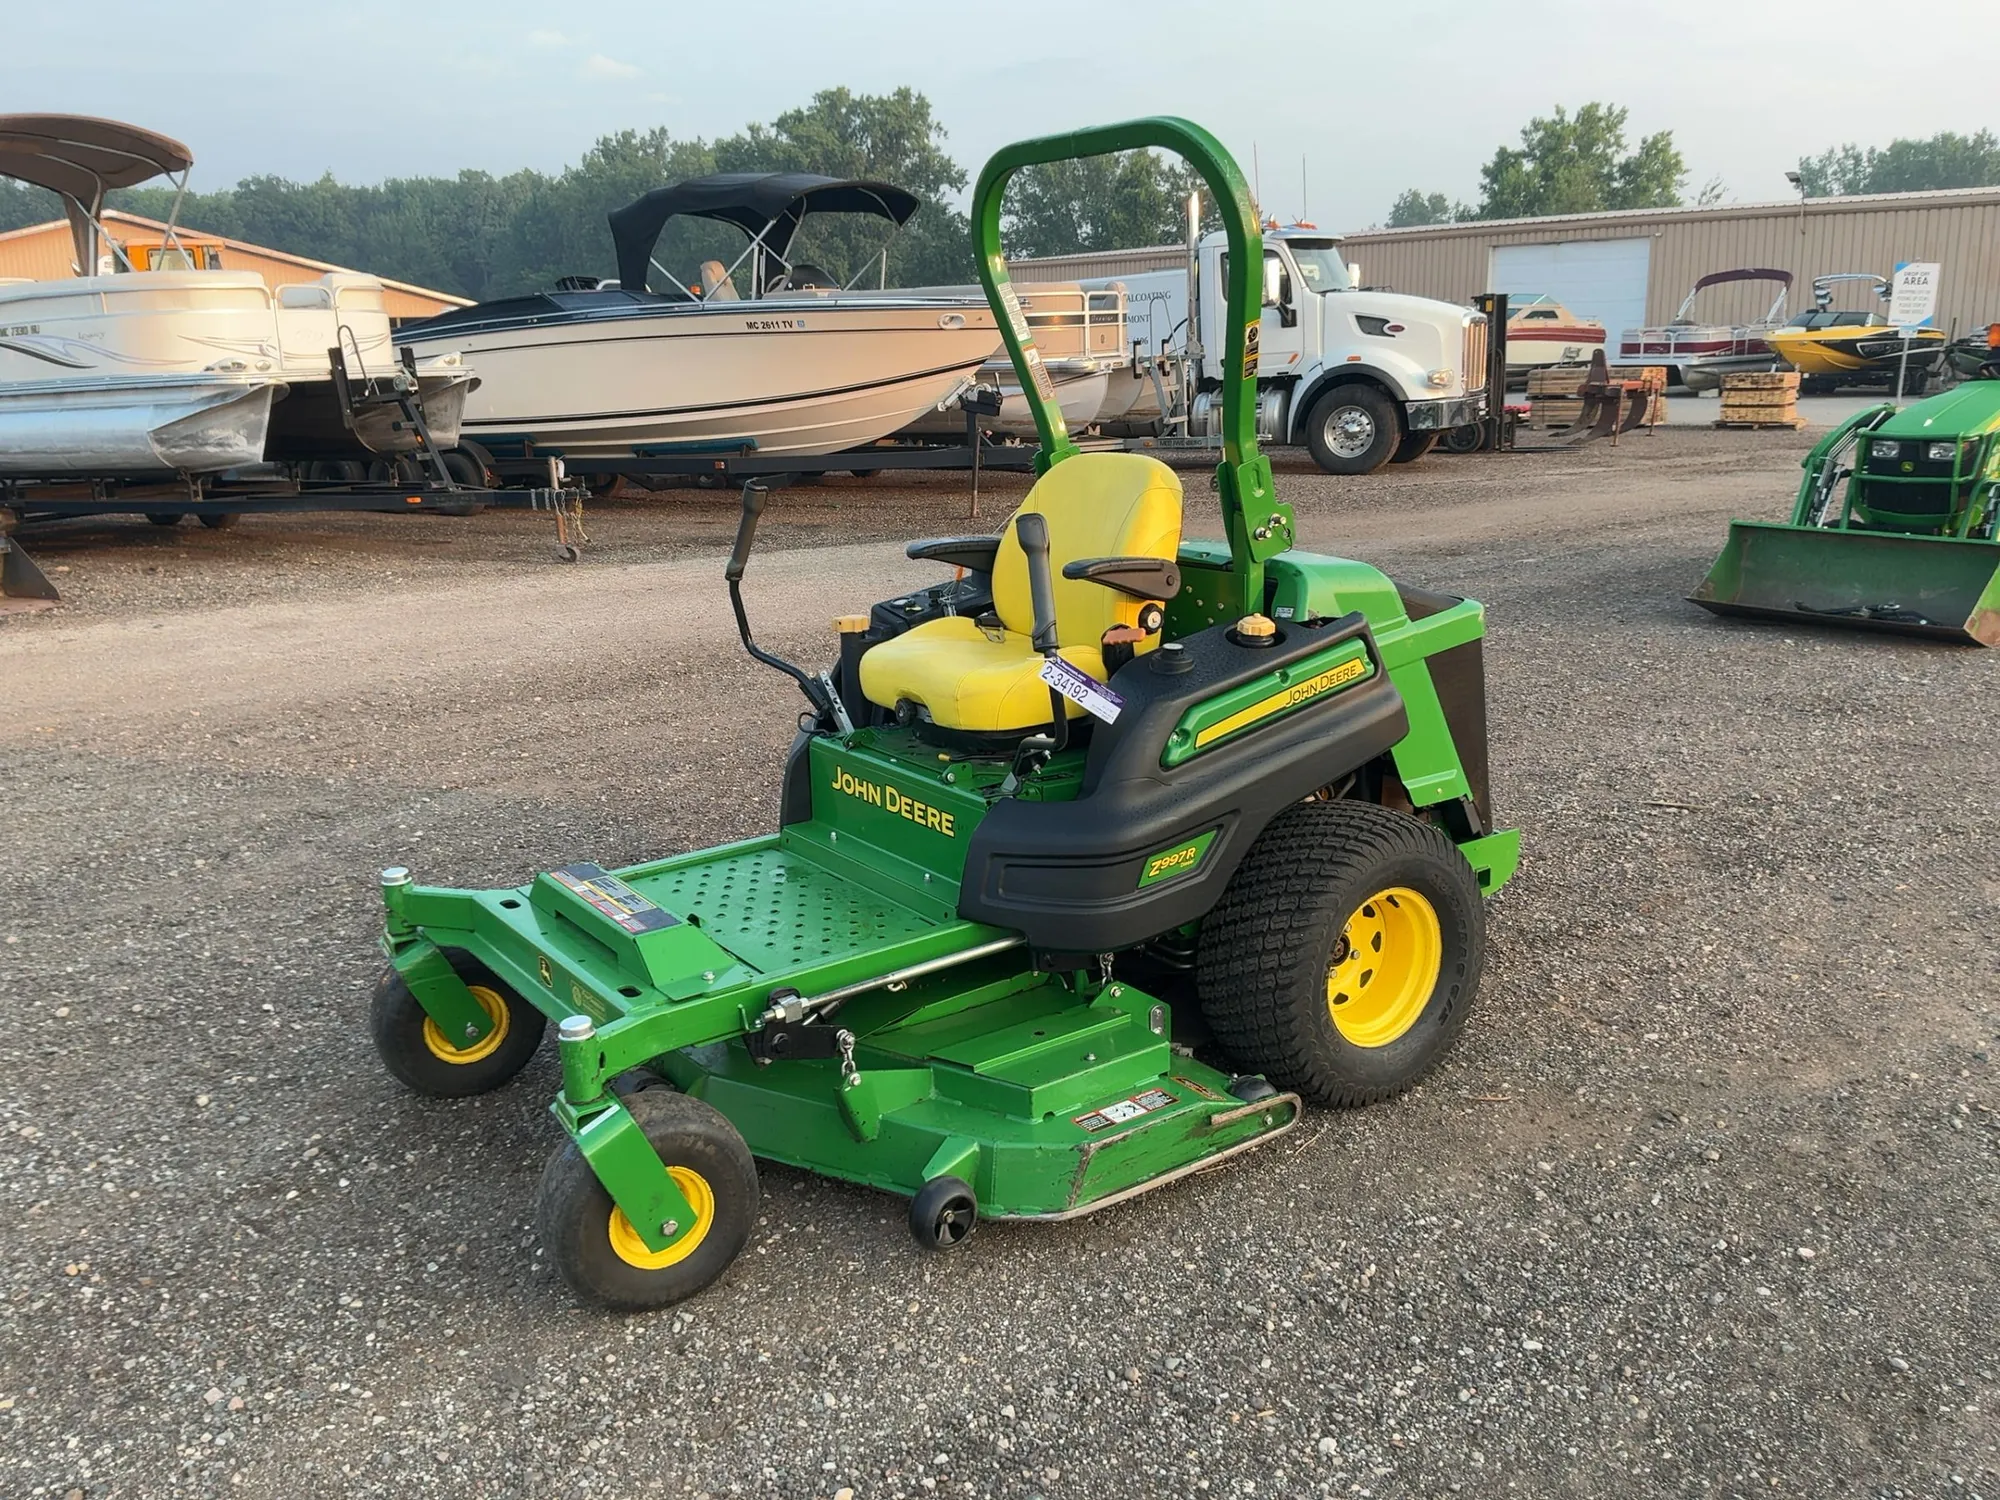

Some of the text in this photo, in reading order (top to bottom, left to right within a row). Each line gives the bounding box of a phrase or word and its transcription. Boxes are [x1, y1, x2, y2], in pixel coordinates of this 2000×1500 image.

[1902, 277, 1929, 286] AREA
[746, 321, 759, 330] MC
[760, 320, 780, 330] 2611
[782, 320, 793, 329] TV
[1041, 665, 1089, 703] 2-34192
[1285, 664, 1357, 706] JOHN DEERE
[831, 765, 955, 838] JOHN DEERE
[1148, 847, 1197, 878] Z997R
